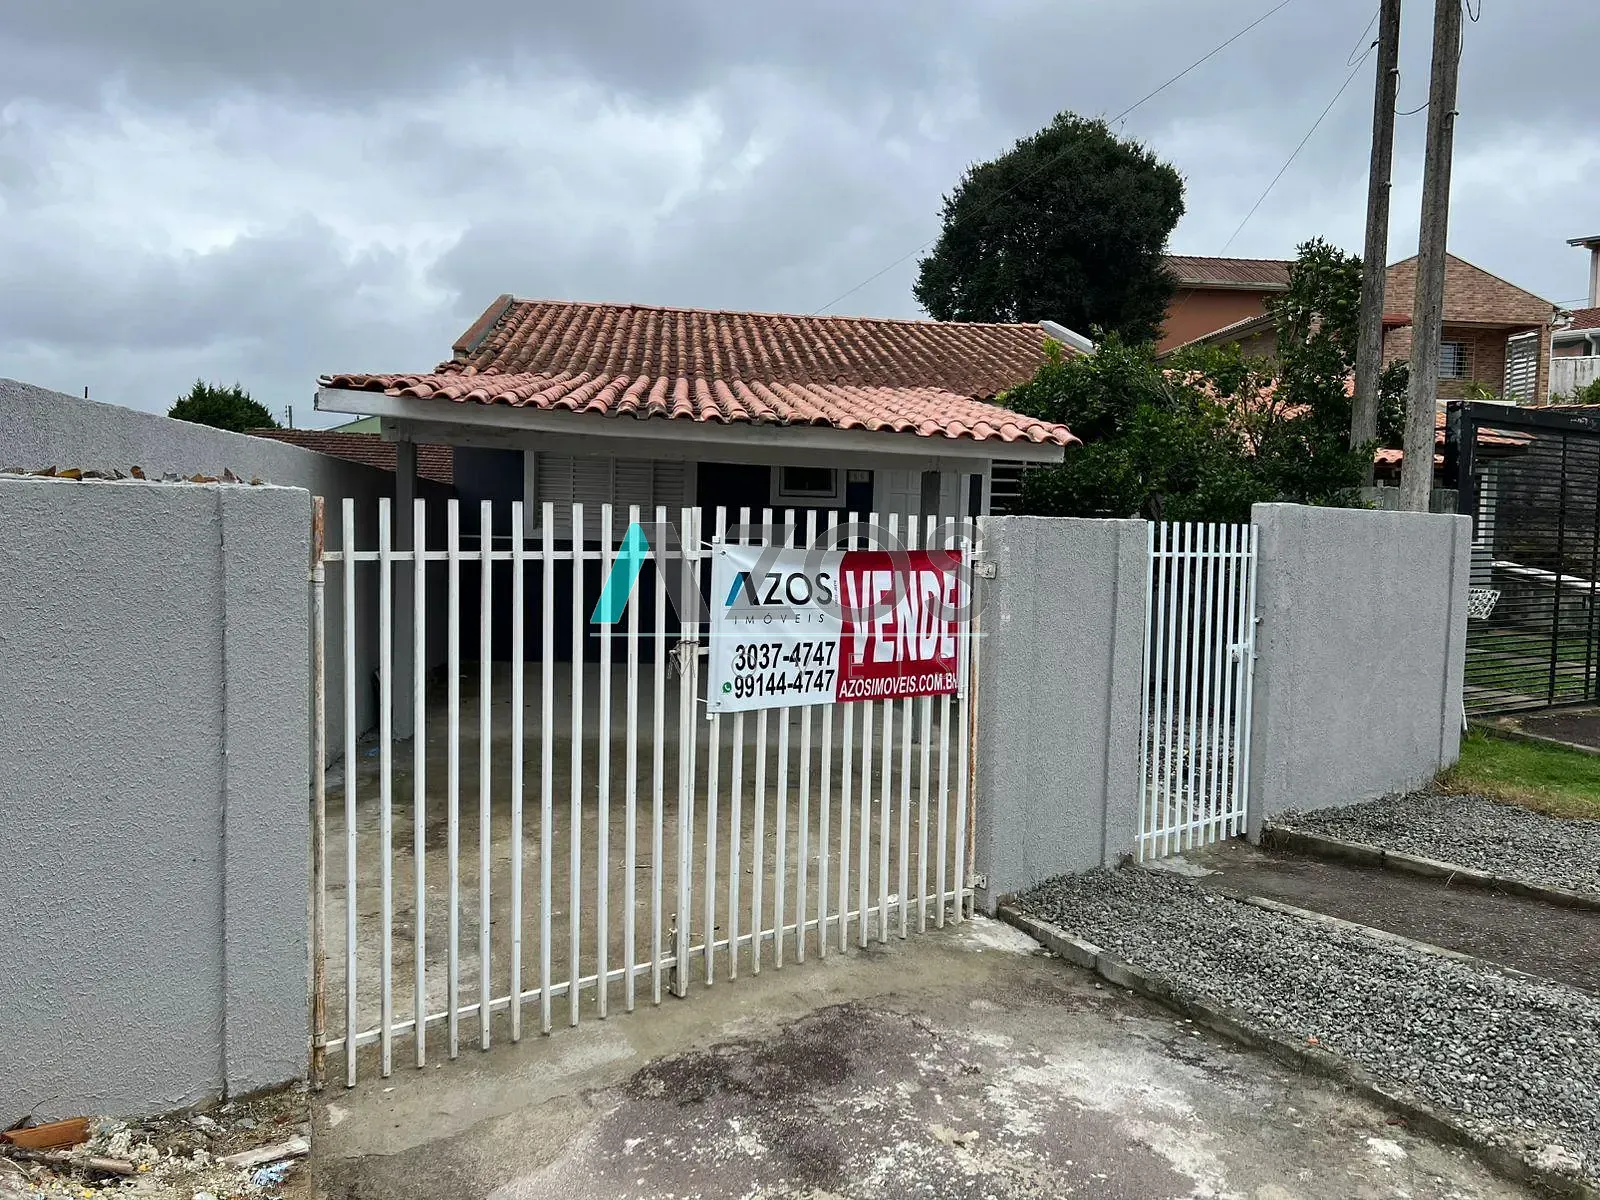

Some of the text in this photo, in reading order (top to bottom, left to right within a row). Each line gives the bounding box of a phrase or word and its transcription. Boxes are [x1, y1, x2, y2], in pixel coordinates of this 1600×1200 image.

[725, 571, 833, 606] AZOS
[734, 613, 825, 625] IMÓVEIS
[845, 570, 956, 664] VENDE
[735, 641, 836, 671] 3037-4747
[734, 669, 835, 699] 99144-4747
